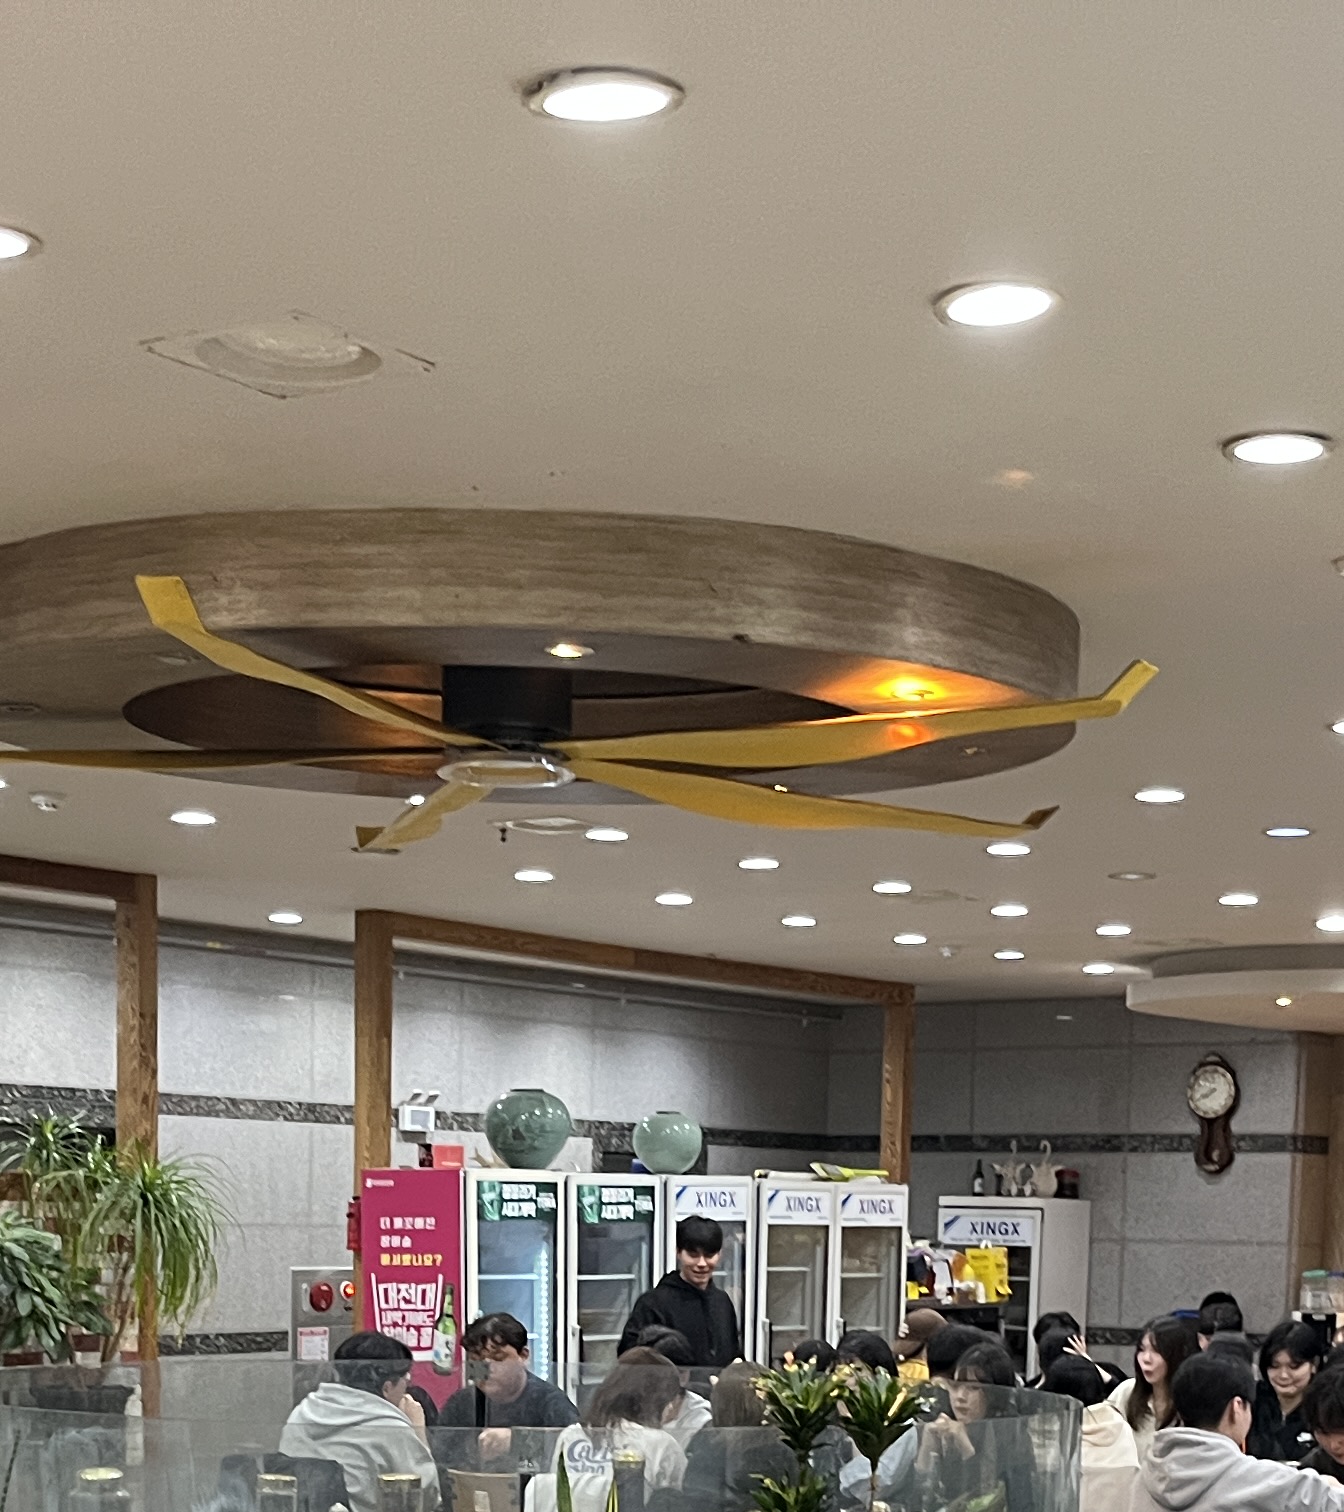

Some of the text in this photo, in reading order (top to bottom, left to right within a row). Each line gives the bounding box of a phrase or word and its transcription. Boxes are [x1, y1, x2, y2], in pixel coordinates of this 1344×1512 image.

[695, 1191, 737, 1208] XINGX
[785, 1196, 822, 1213] XINGX
[859, 1199, 895, 1214] XINGX
[970, 1221, 1020, 1236] XINGX
[377, 1282, 437, 1310] 대전대
